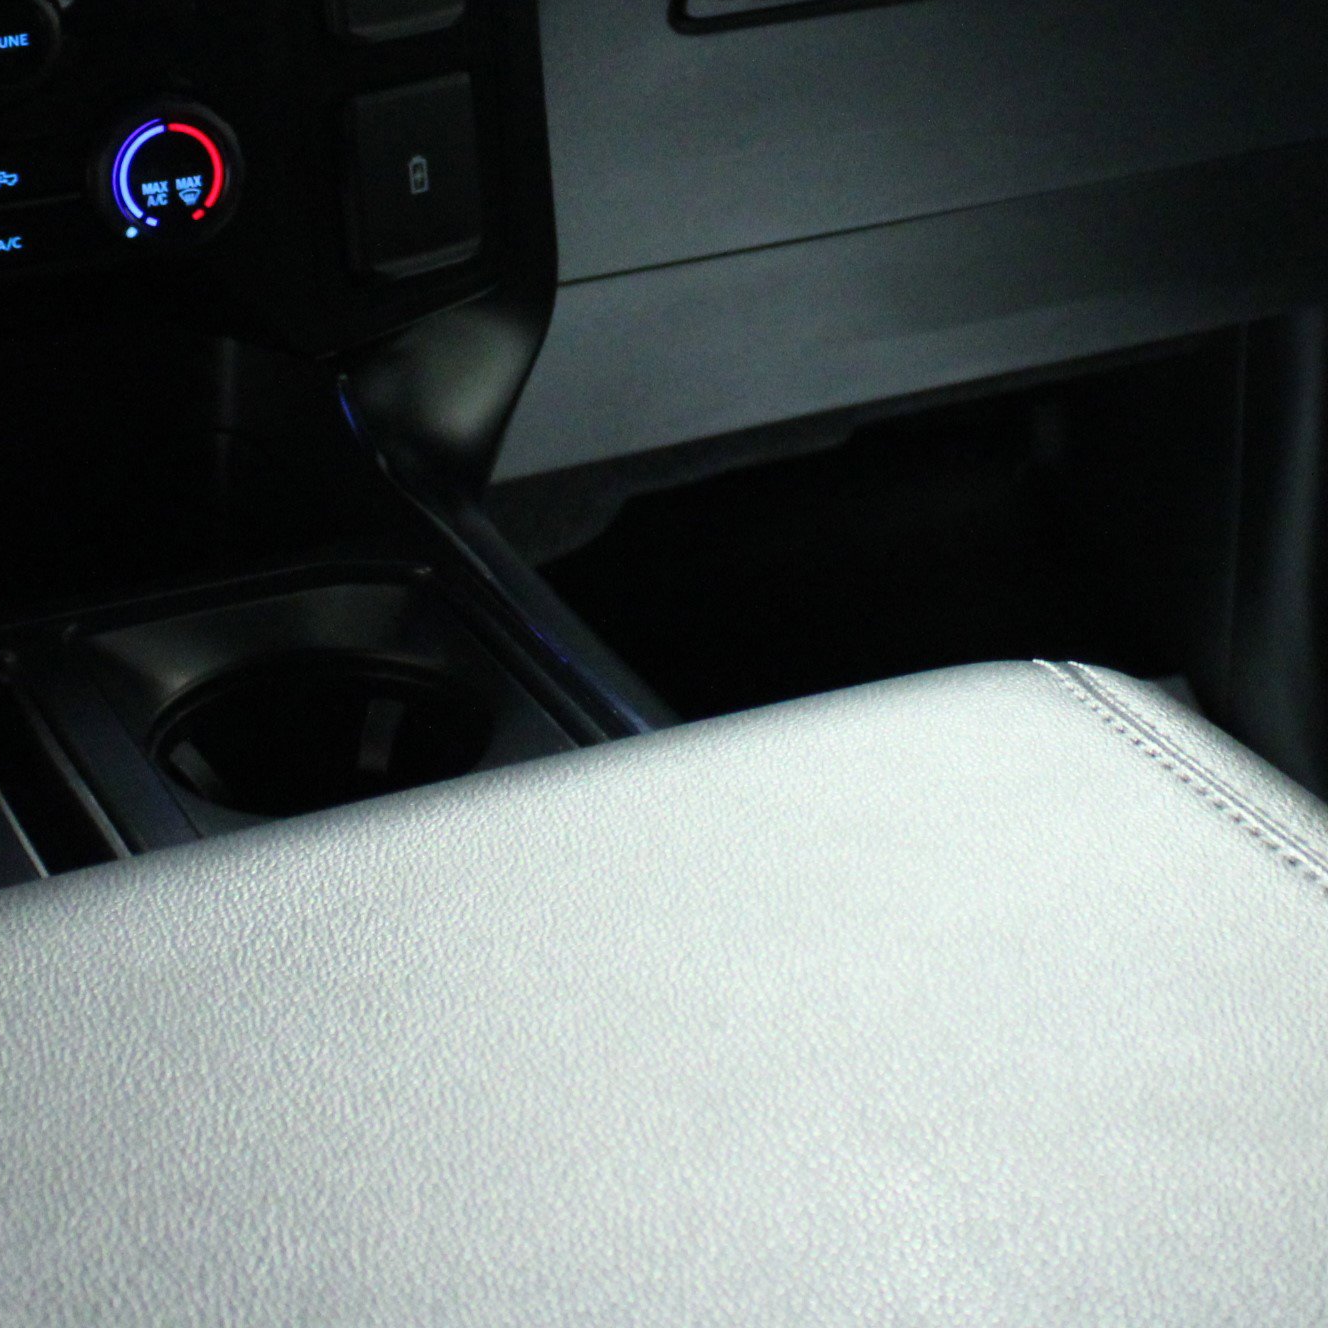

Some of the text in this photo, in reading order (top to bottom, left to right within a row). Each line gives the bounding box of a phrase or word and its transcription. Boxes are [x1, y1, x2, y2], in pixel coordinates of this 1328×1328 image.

[141, 180, 169, 195] MAX
[175, 174, 203, 190] MAX
[146, 191, 169, 207] A/C
